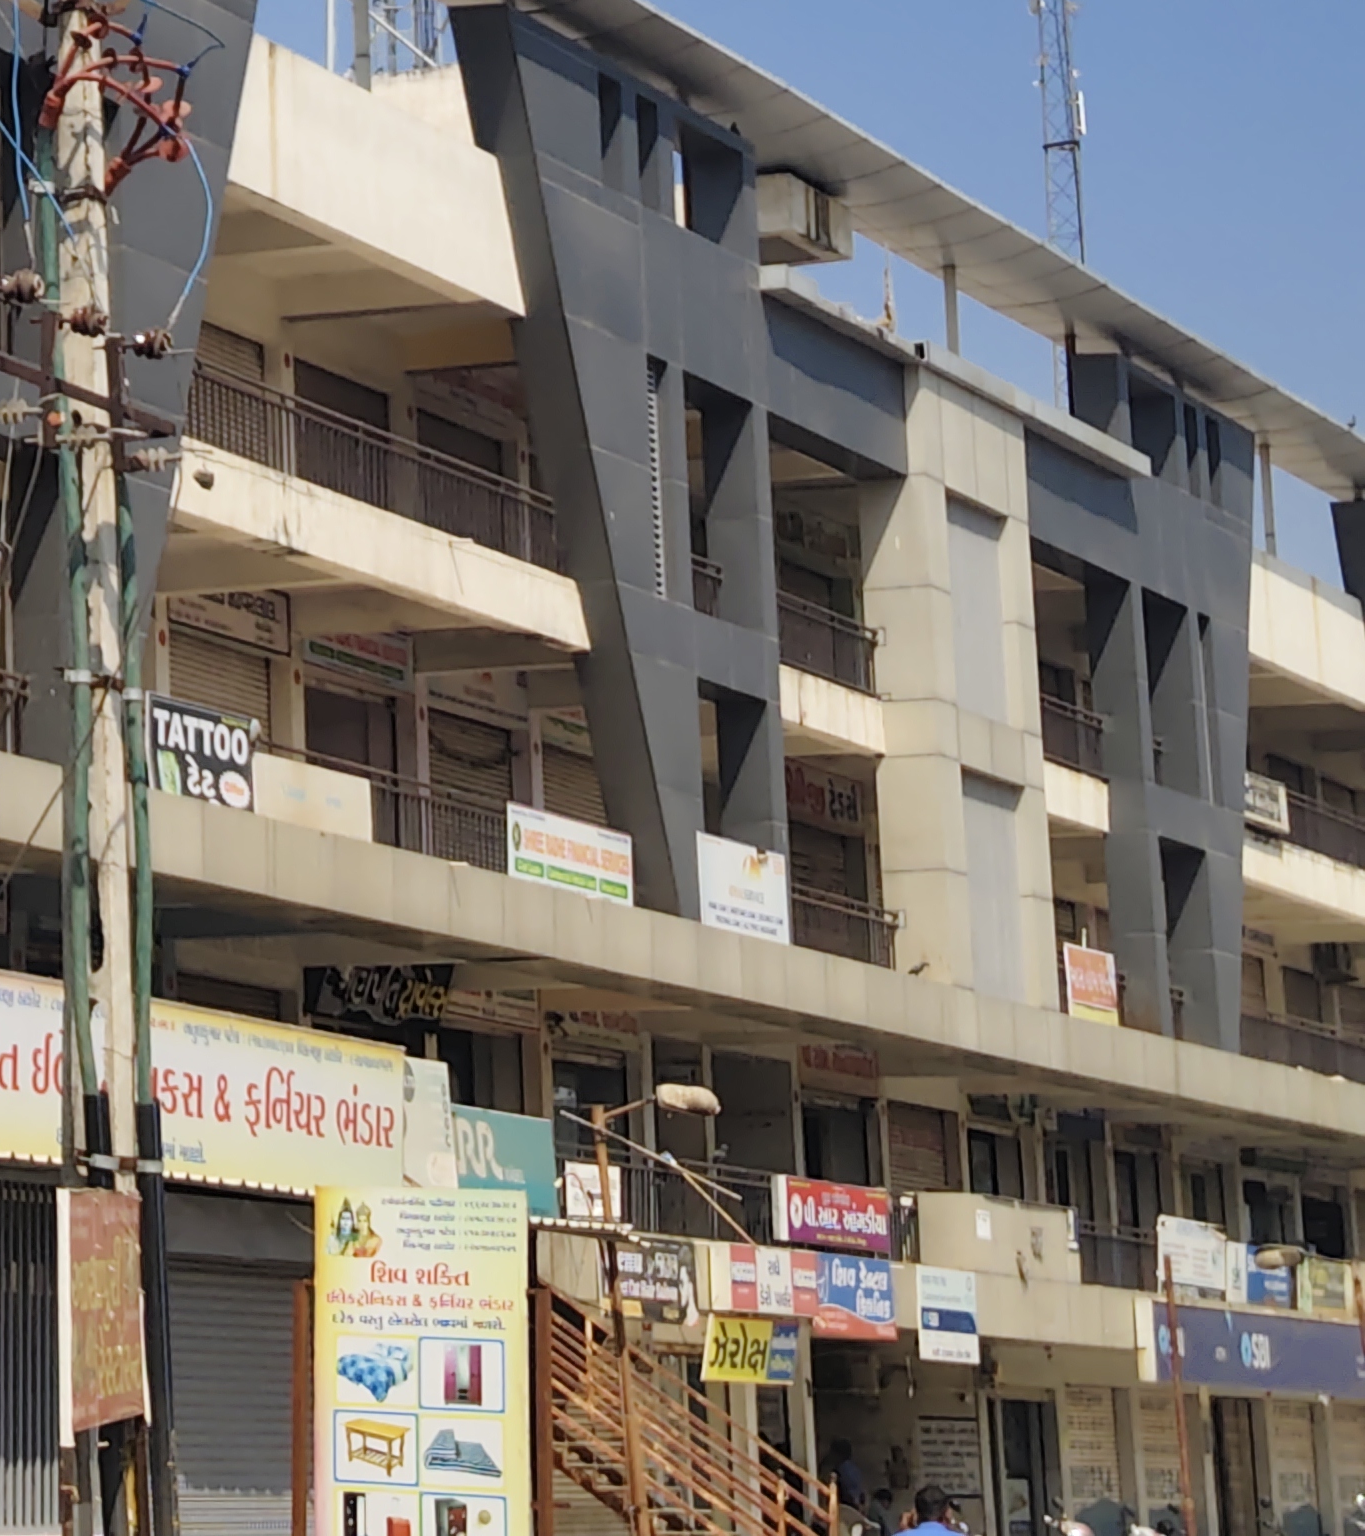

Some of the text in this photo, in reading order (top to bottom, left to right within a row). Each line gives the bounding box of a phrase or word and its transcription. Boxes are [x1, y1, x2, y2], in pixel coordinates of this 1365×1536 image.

[153, 707, 248, 766] TATTOO
[214, 1073, 231, 1123] &
[336, 1083, 395, 1149] ભંડાર
[370, 1260, 408, 1284] શિવ
[412, 1293, 422, 1308] &
[1251, 1332, 1272, 1370] SBI
